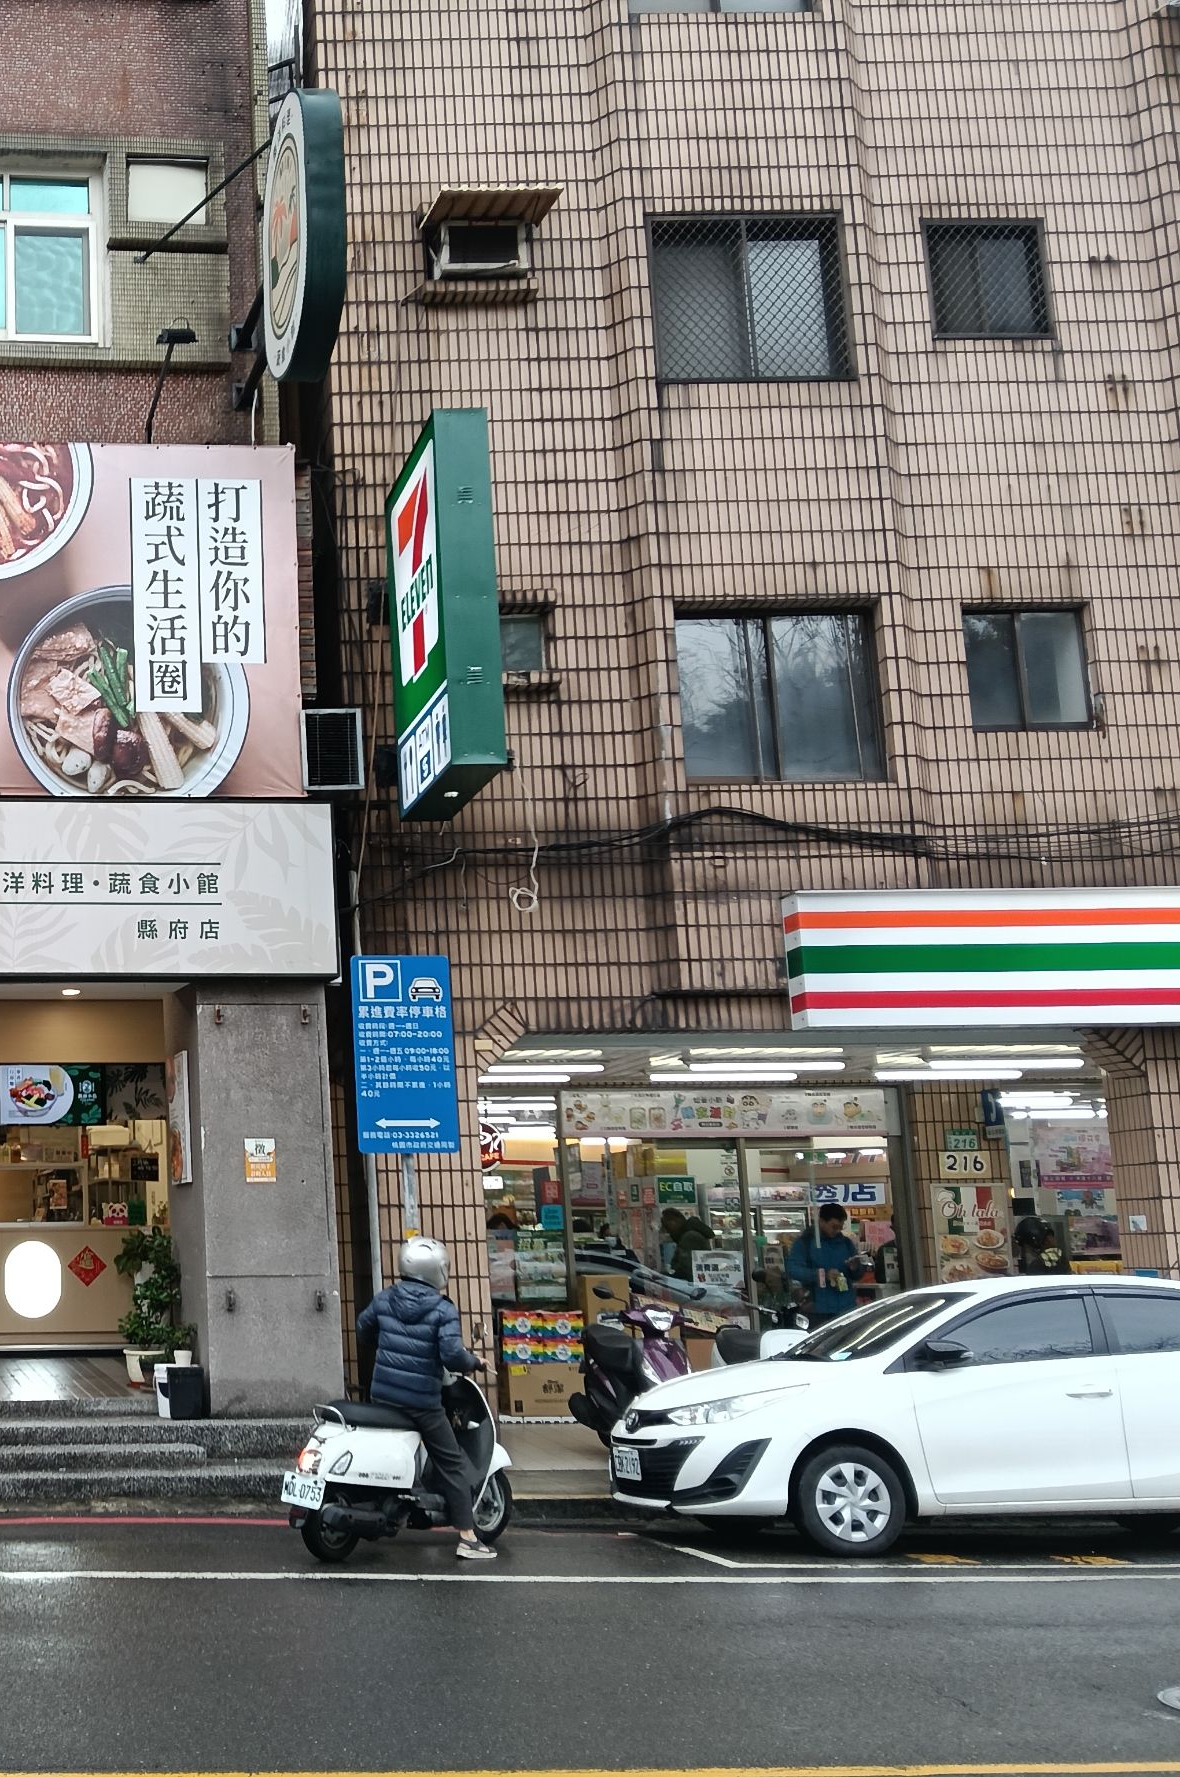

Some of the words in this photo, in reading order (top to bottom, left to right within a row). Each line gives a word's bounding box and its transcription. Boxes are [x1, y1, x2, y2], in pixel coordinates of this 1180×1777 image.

[206, 482, 251, 657] 打造你的
[143, 481, 188, 701] 蔬式生活圈
[136, 919, 220, 940] 縣府店
[358, 1005, 447, 1019] 累進費率停車格
[953, 1138, 976, 1149] 216
[946, 1153, 985, 1172] 216
[941, 1200, 967, 1218] Oh
